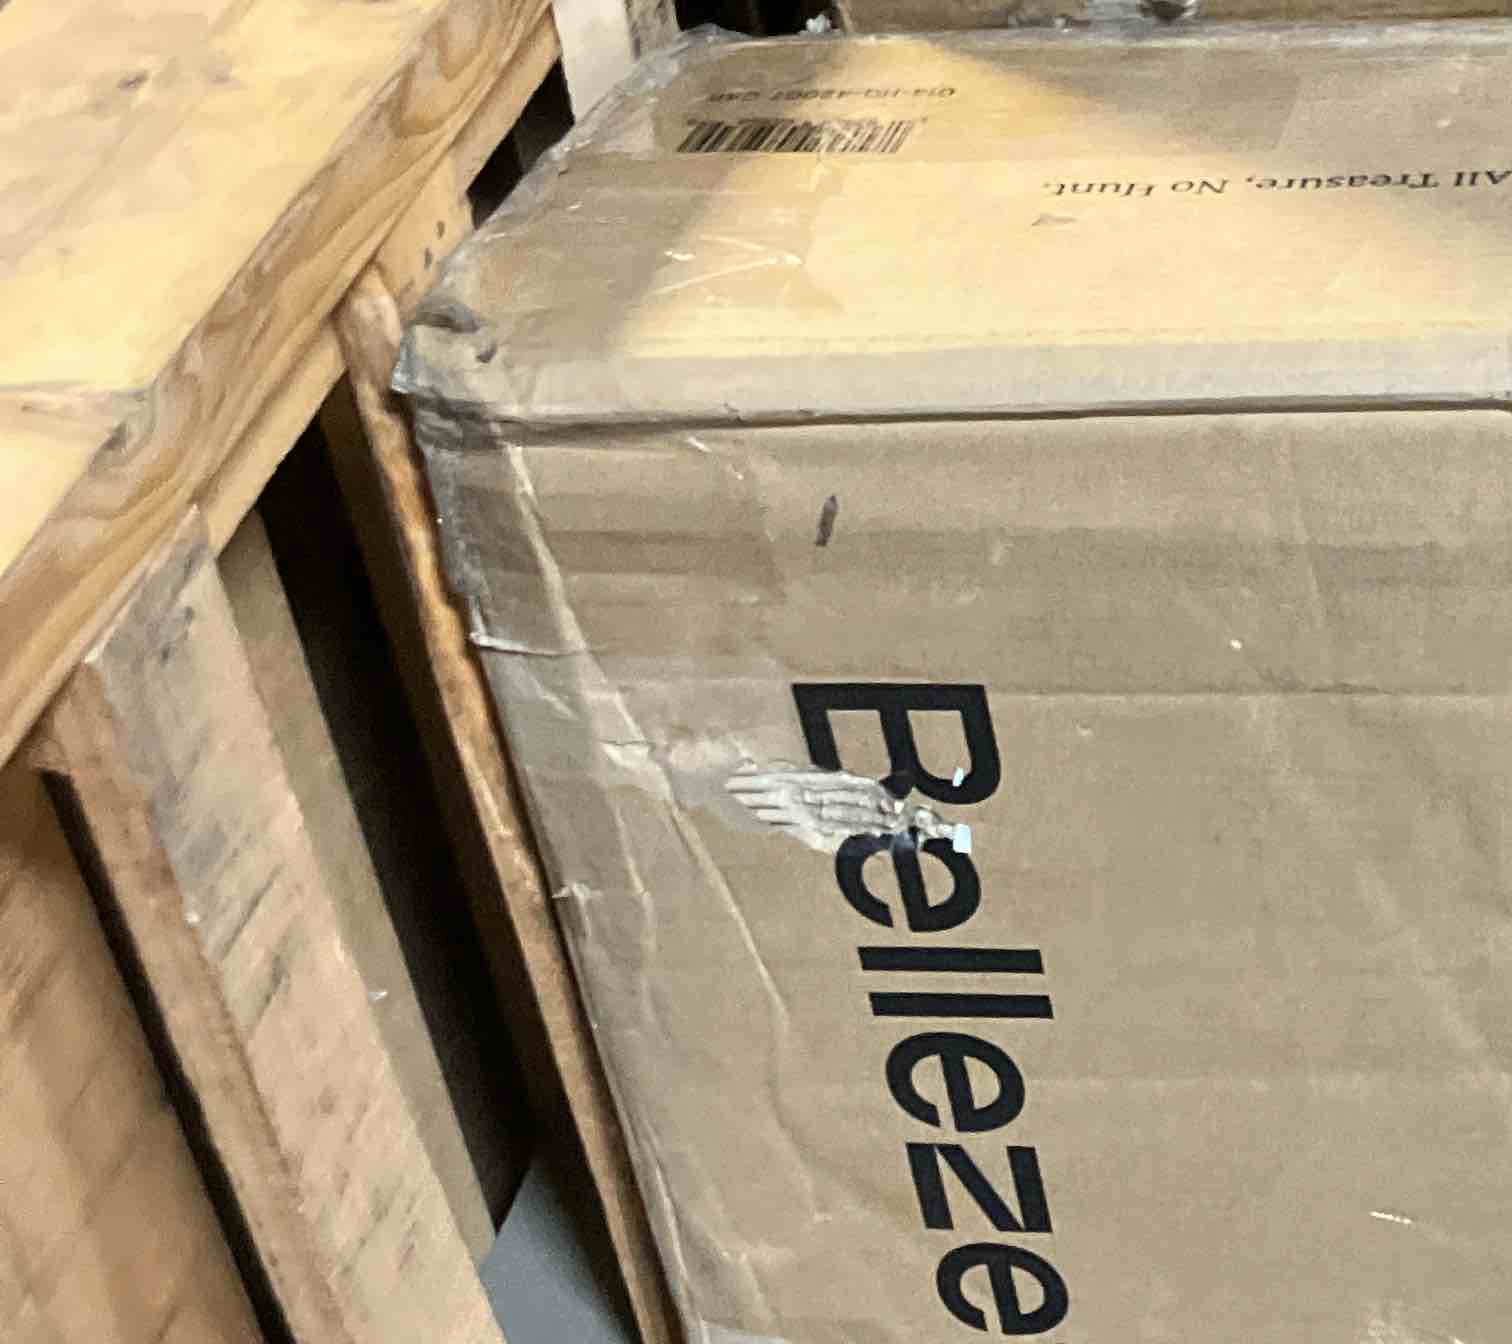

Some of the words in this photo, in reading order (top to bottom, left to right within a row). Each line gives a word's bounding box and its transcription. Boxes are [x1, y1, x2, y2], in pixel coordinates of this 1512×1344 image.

[1043, 181, 1155, 197] Hunt.
[1170, 177, 1231, 195] No
[1246, 171, 1441, 191] Treasure,
[790, 682, 1070, 1337] Belleze
